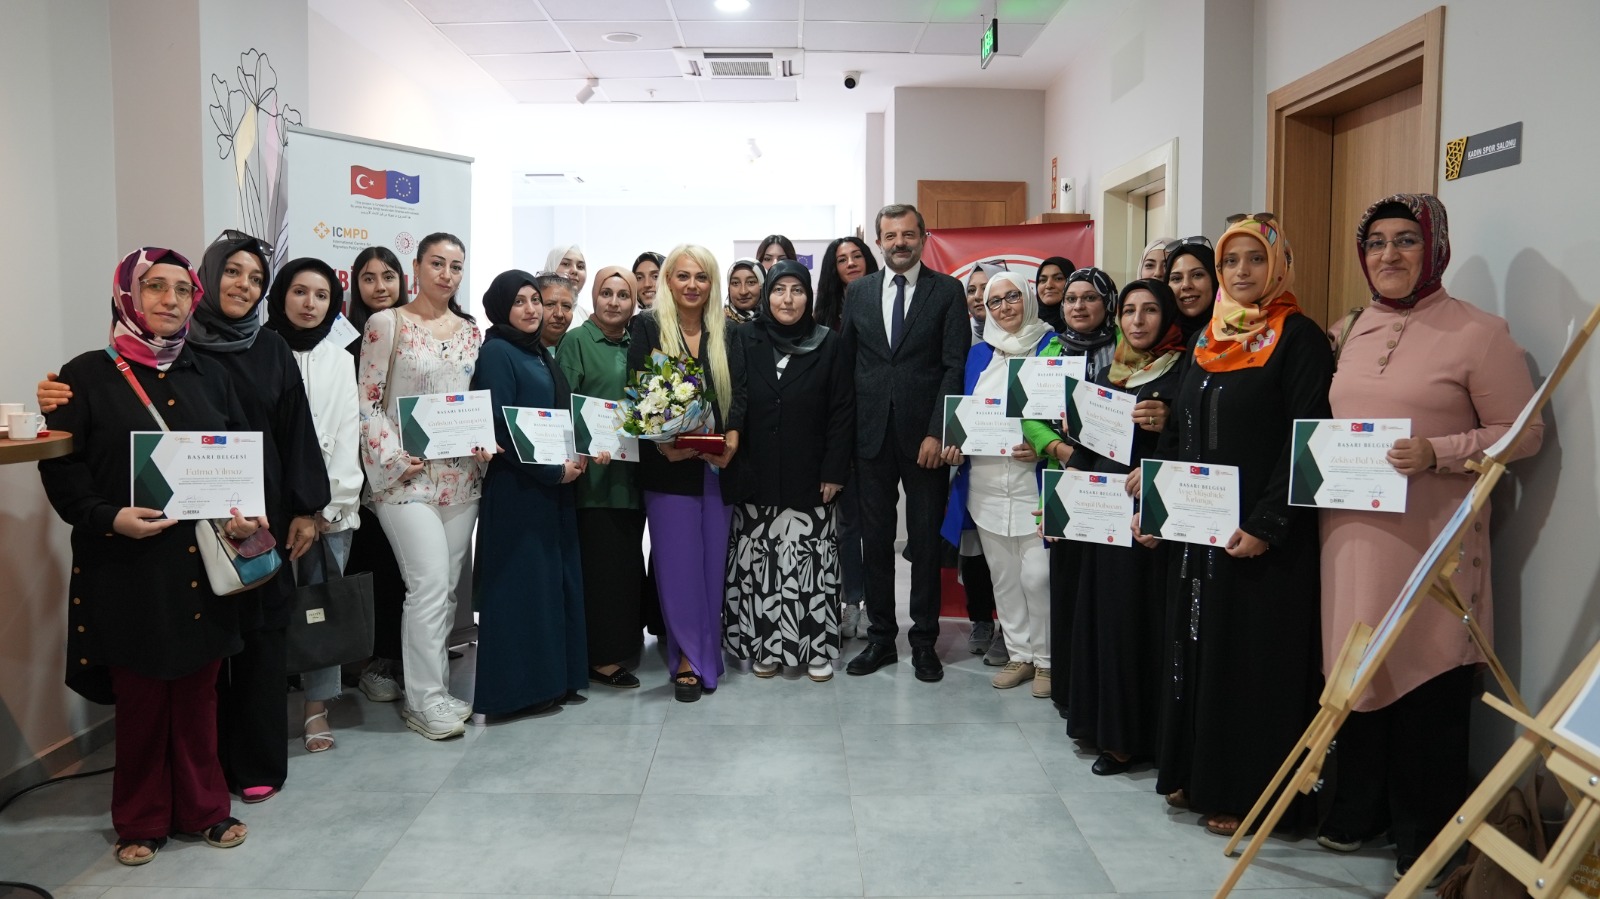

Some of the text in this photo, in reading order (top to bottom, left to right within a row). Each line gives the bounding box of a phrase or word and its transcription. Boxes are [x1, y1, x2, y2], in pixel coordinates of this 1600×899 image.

[1468, 138, 1516, 159] KADIN SPOR SALONU
[332, 226, 368, 240] ICMPD
[214, 468, 242, 476] Yılmaz
